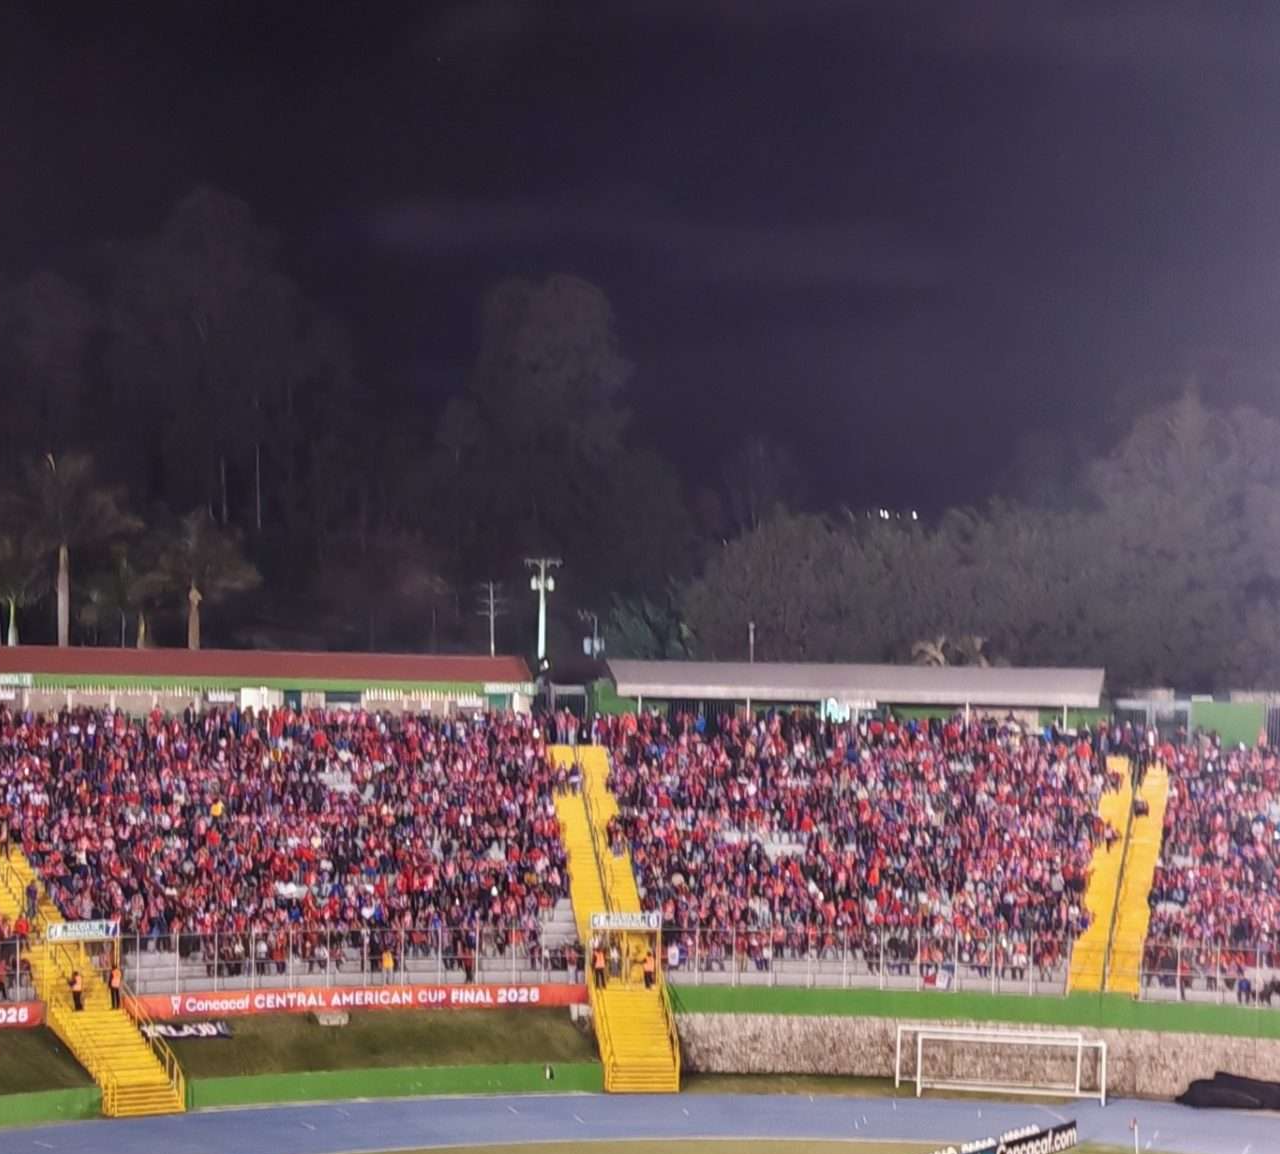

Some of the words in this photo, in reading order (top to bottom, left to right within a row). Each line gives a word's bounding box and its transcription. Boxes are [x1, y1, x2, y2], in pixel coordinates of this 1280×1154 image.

[185, 997, 250, 1013] Concacaf
[254, 991, 326, 1009] CENTRAL
[331, 989, 412, 1006] AMERICAN
[417, 990, 447, 1004] CUP
[451, 988, 493, 1003] FINAL
[497, 987, 540, 1003] 2025
